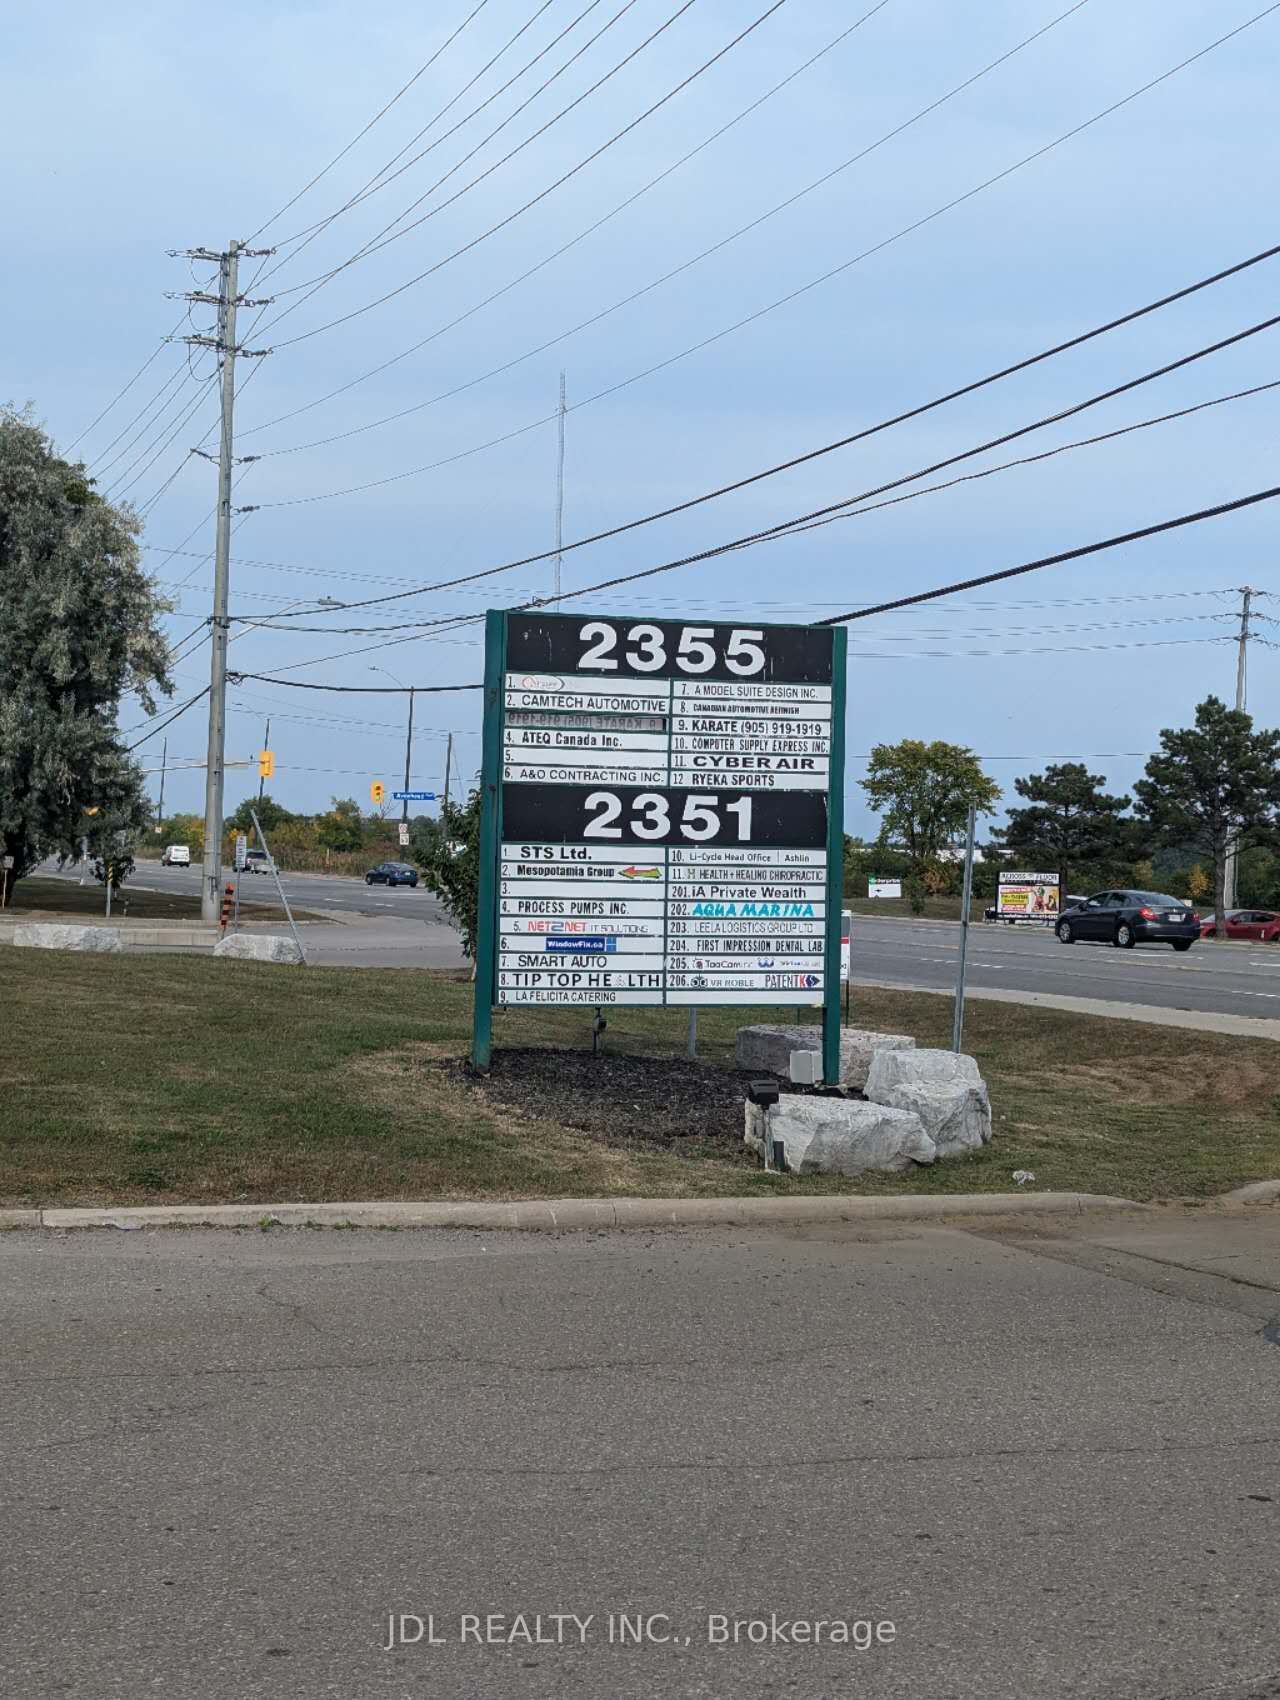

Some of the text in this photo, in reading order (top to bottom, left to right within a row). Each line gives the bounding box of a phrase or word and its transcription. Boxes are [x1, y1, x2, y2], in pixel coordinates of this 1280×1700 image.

[578, 622, 766, 676] 2355
[694, 685, 701, 695] A
[703, 685, 734, 697] MODEL
[737, 686, 763, 697] SUITE
[766, 687, 798, 698] DESIGN
[801, 688, 818, 699] INC.
[521, 694, 584, 709] CAMTECH
[586, 698, 667, 712] AUTOMOTIVE
[727, 704, 769, 714] AUTOMOTIVE
[678, 720, 822, 736] 9. KARATE (905) 919-1919
[522, 732, 551, 745] ATEQ
[556, 733, 597, 746] Canada
[602, 735, 622, 747] Inc.
[675, 737, 828, 753] 10. COMPUTER SUPPLY EXPRESS INC.
[505, 750, 514, 762] 5.
[693, 756, 772, 769] CYBER
[776, 758, 815, 770] AIR
[520, 768, 546, 779] A&O
[549, 769, 637, 782] CONTRACTING
[640, 772, 664, 783] INC.
[692, 774, 728, 786] RYEKA
[731, 775, 775, 787] SPORTS
[583, 791, 752, 841] 2351
[520, 845, 554, 859] STS
[560, 847, 592, 860] Ltd.
[724, 853, 744, 861] Head
[747, 853, 771, 862] Office
[784, 854, 810, 862] Ashlin
[517, 864, 584, 878] Mesopotamia
[587, 866, 615, 878] Group
[699, 869, 729, 880] HEALTH
[735, 870, 767, 881] HEALING
[769, 870, 823, 881] CHIROPRACTIC
[502, 882, 511, 895] 3.
[672, 886, 807, 899] 201. iA Private Wealth
[518, 901, 565, 914] PROCESS
[570, 902, 605, 914] PUMPS
[609, 903, 629, 915] INC.
[670, 903, 690, 916] 202.
[740, 904, 814, 917] MARINA
[528, 921, 588, 932] NET2NET
[722, 922, 765, 934] LOGISTICS
[501, 937, 510, 950] 6.
[670, 940, 823, 952] 204. FIRST IMPRESSION DENTAL LAB
[518, 955, 567, 968] SMART
[571, 956, 607, 969] AUTO
[669, 957, 690, 970] 205.
[512, 973, 541, 986] TIP
[548, 973, 582, 986] TOP
[669, 974, 690, 987] 206.
[515, 991, 527, 1000] LA
[529, 991, 568, 1002] FELICITA
[570, 991, 616, 1002] CATERING
